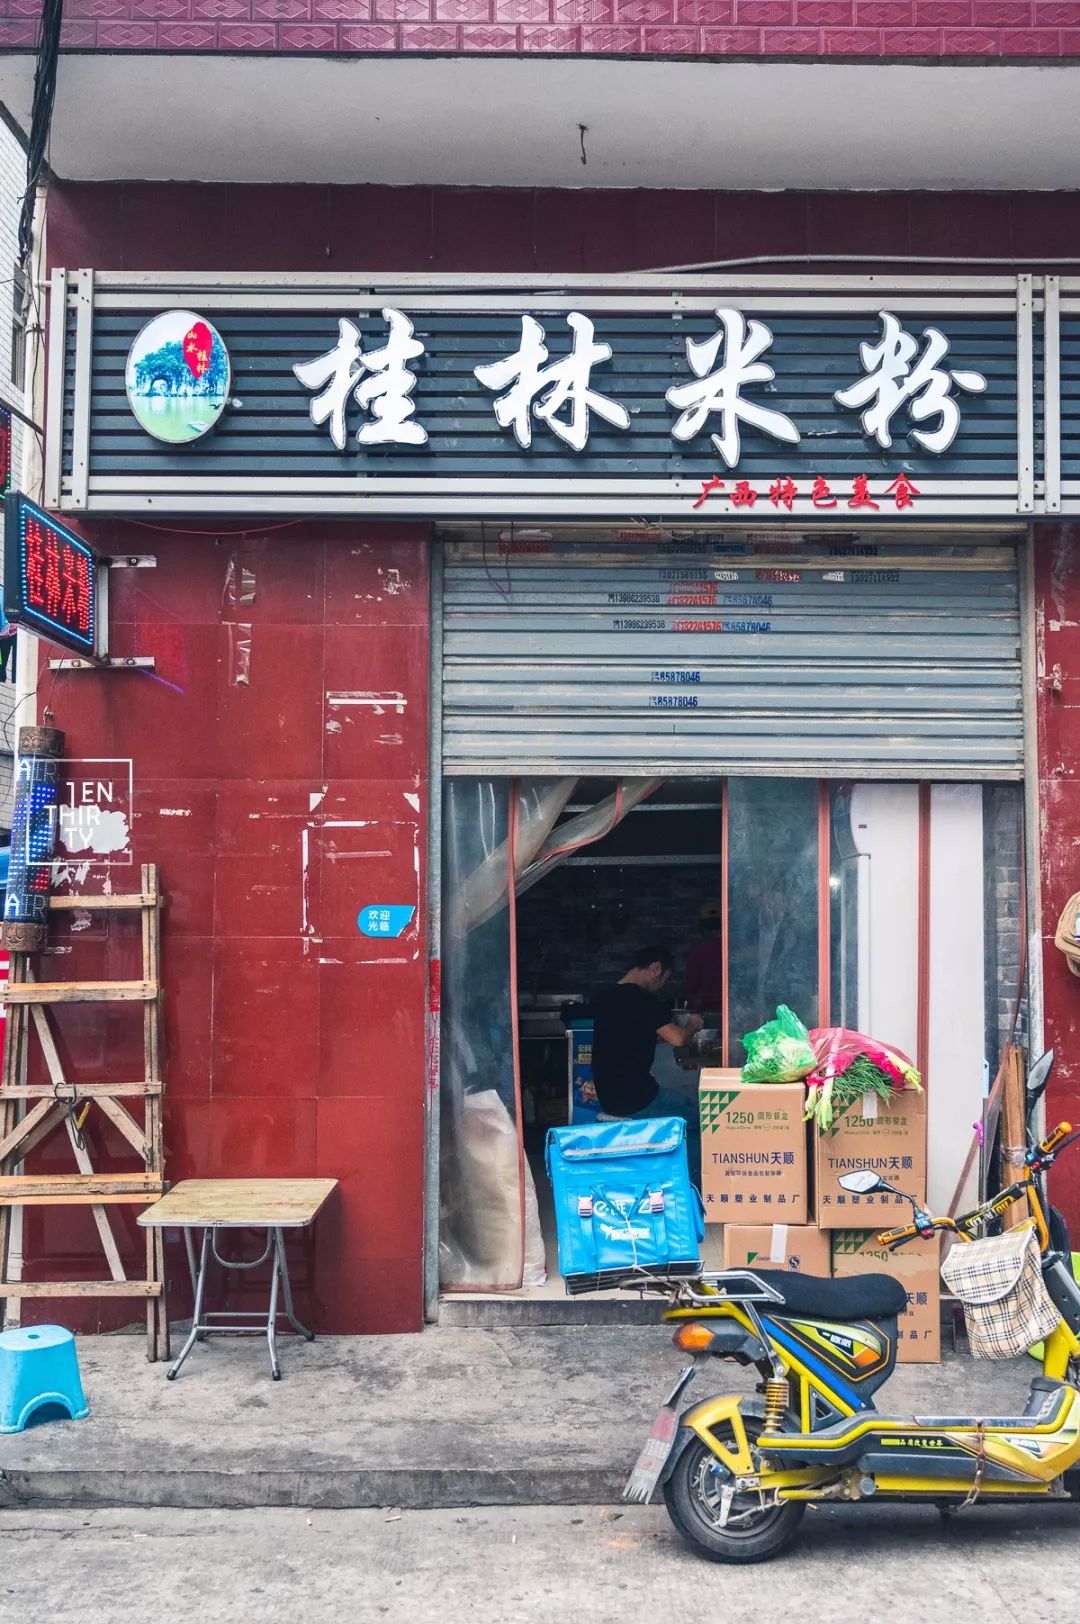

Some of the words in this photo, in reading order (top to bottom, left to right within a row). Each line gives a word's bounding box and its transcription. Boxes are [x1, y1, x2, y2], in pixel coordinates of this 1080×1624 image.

[292, 307, 988, 469] 桂林米粉
[692, 473, 921, 511] 广西特色美食
[368, 910, 390, 921] 欢迎
[368, 921, 390, 932] 光临
[726, 1111, 754, 1124] 1250
[844, 1115, 873, 1128] 1250
[712, 1153, 769, 1164] TIANSHUN
[770, 1152, 794, 1164] 天顺
[829, 1158, 887, 1169] TIANSHUN
[888, 1156, 912, 1169] 天顺
[706, 1194, 800, 1203] 天顺塑业制品厂
